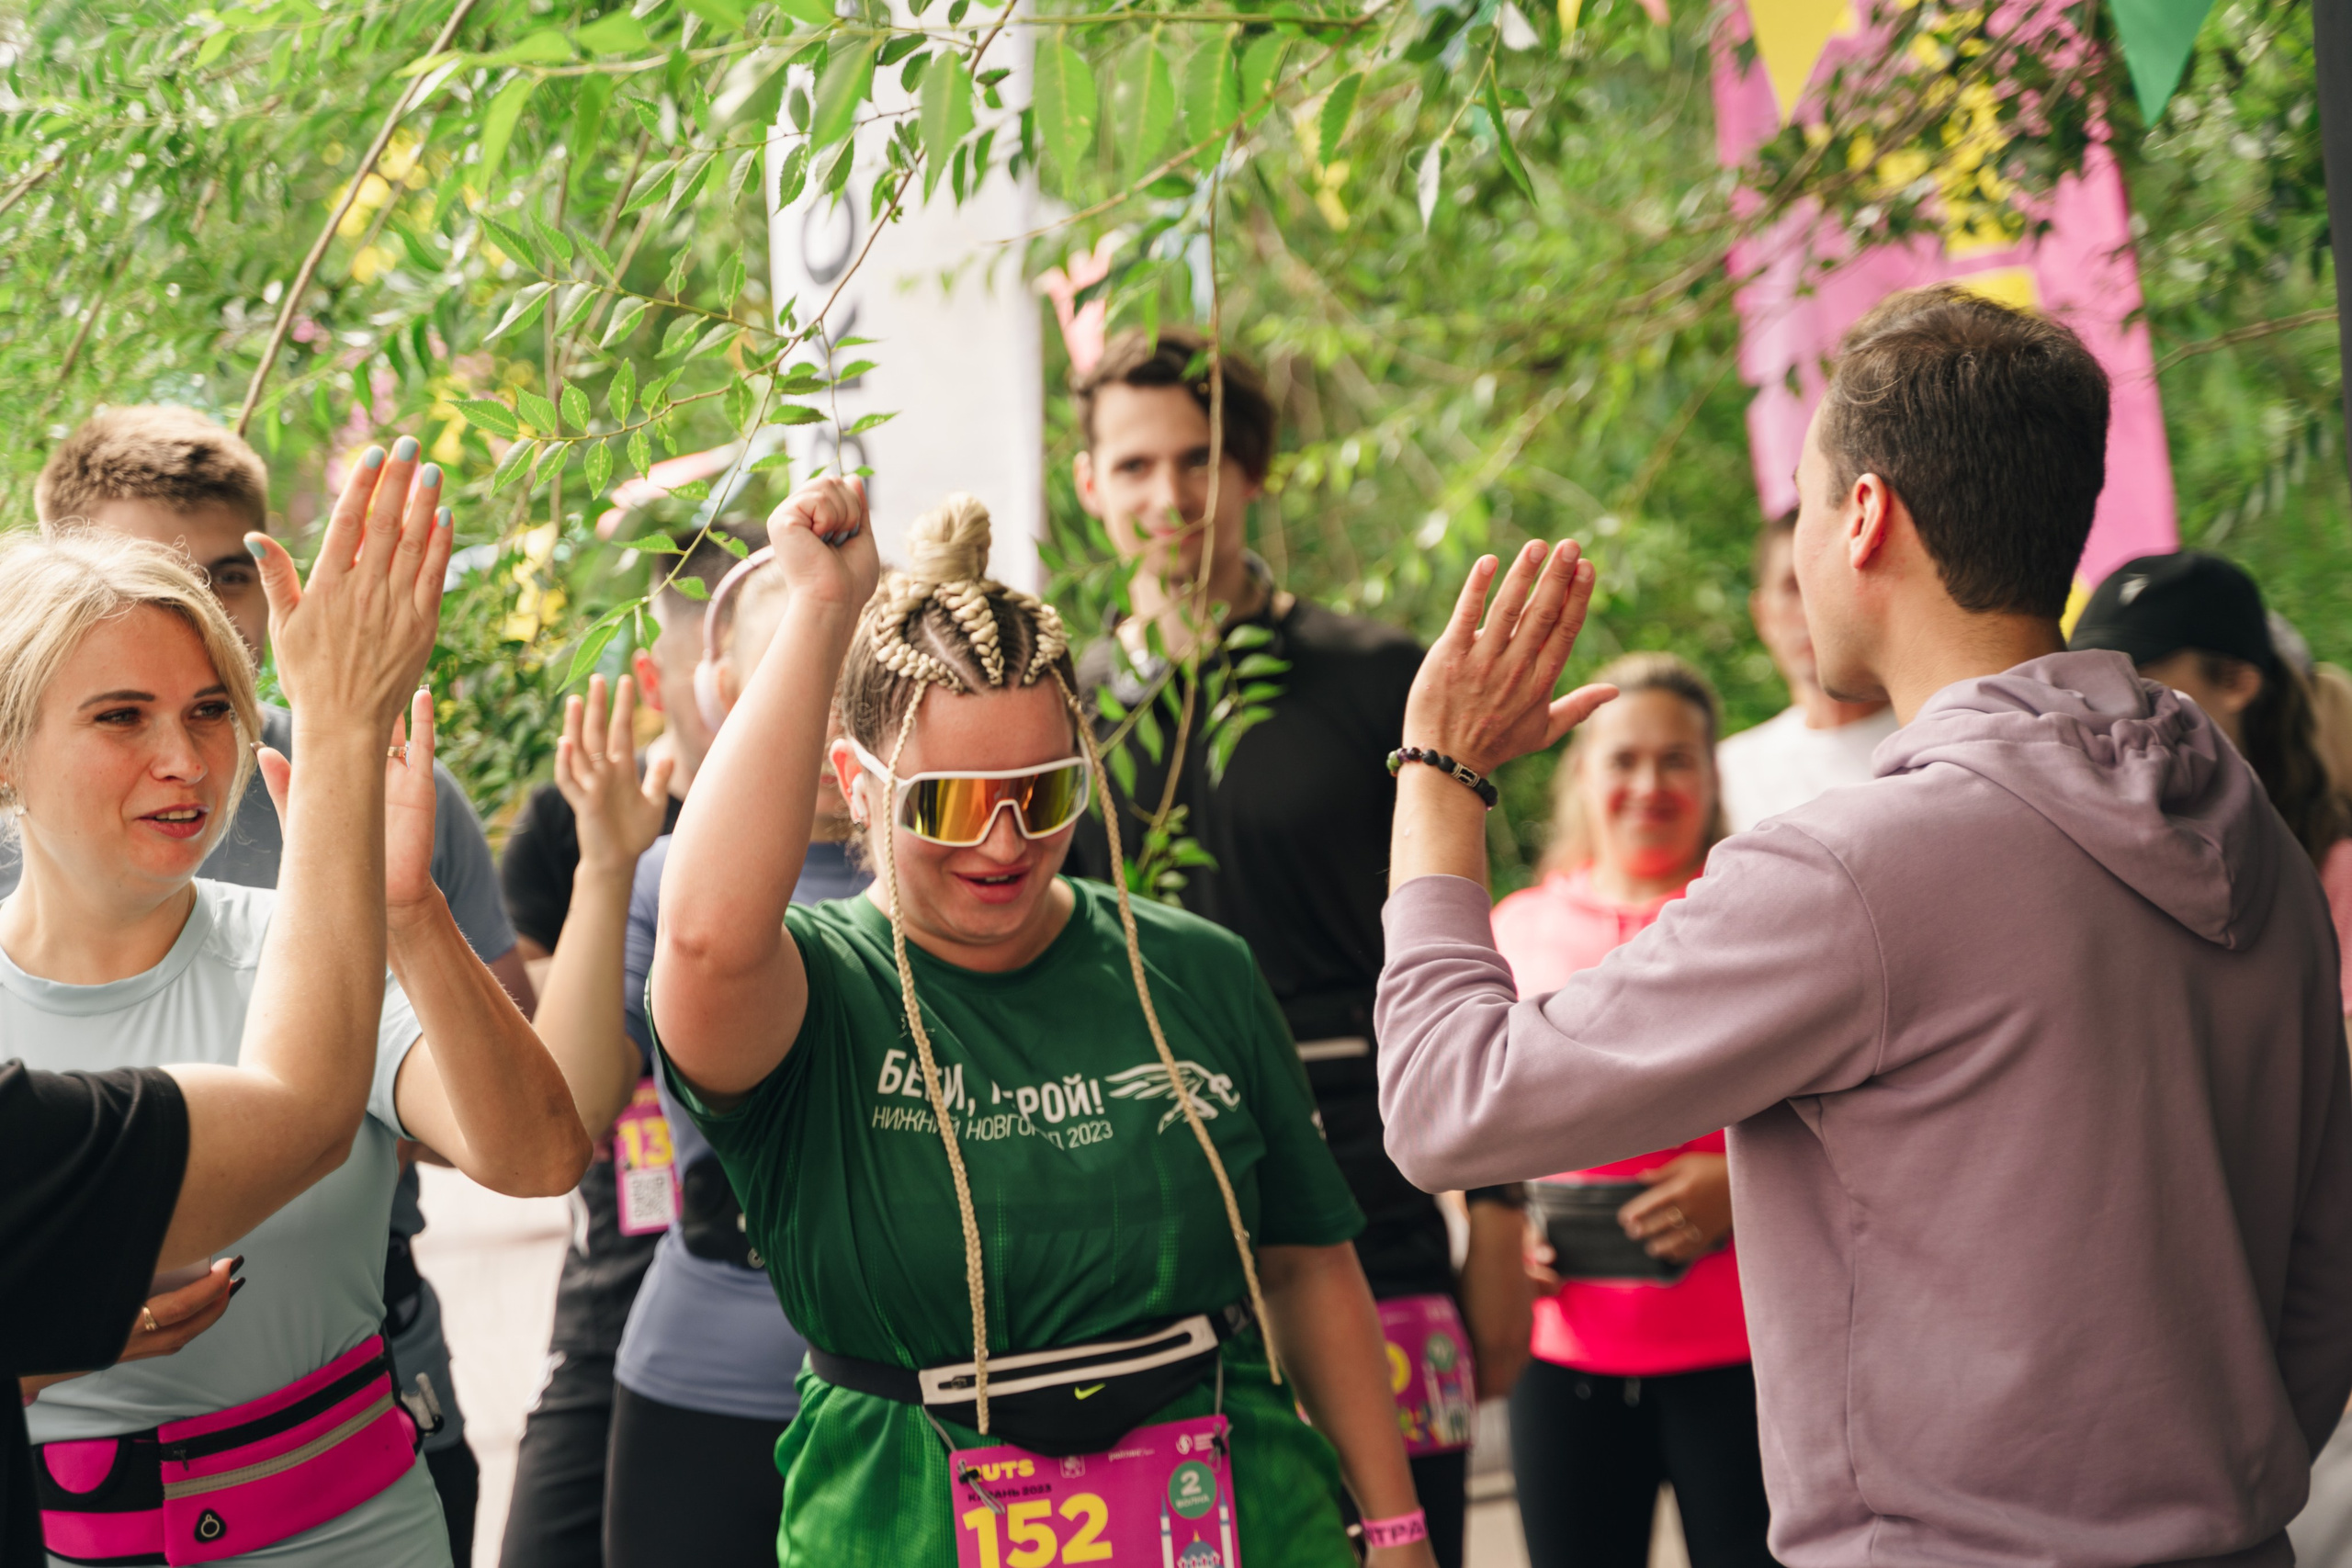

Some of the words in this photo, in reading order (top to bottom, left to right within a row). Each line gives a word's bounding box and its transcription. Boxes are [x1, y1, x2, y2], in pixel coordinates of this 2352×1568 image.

[1066, 1120, 1114, 1148] 2023
[1180, 1470, 1203, 1497] 2
[962, 1492, 1114, 1568] 152
